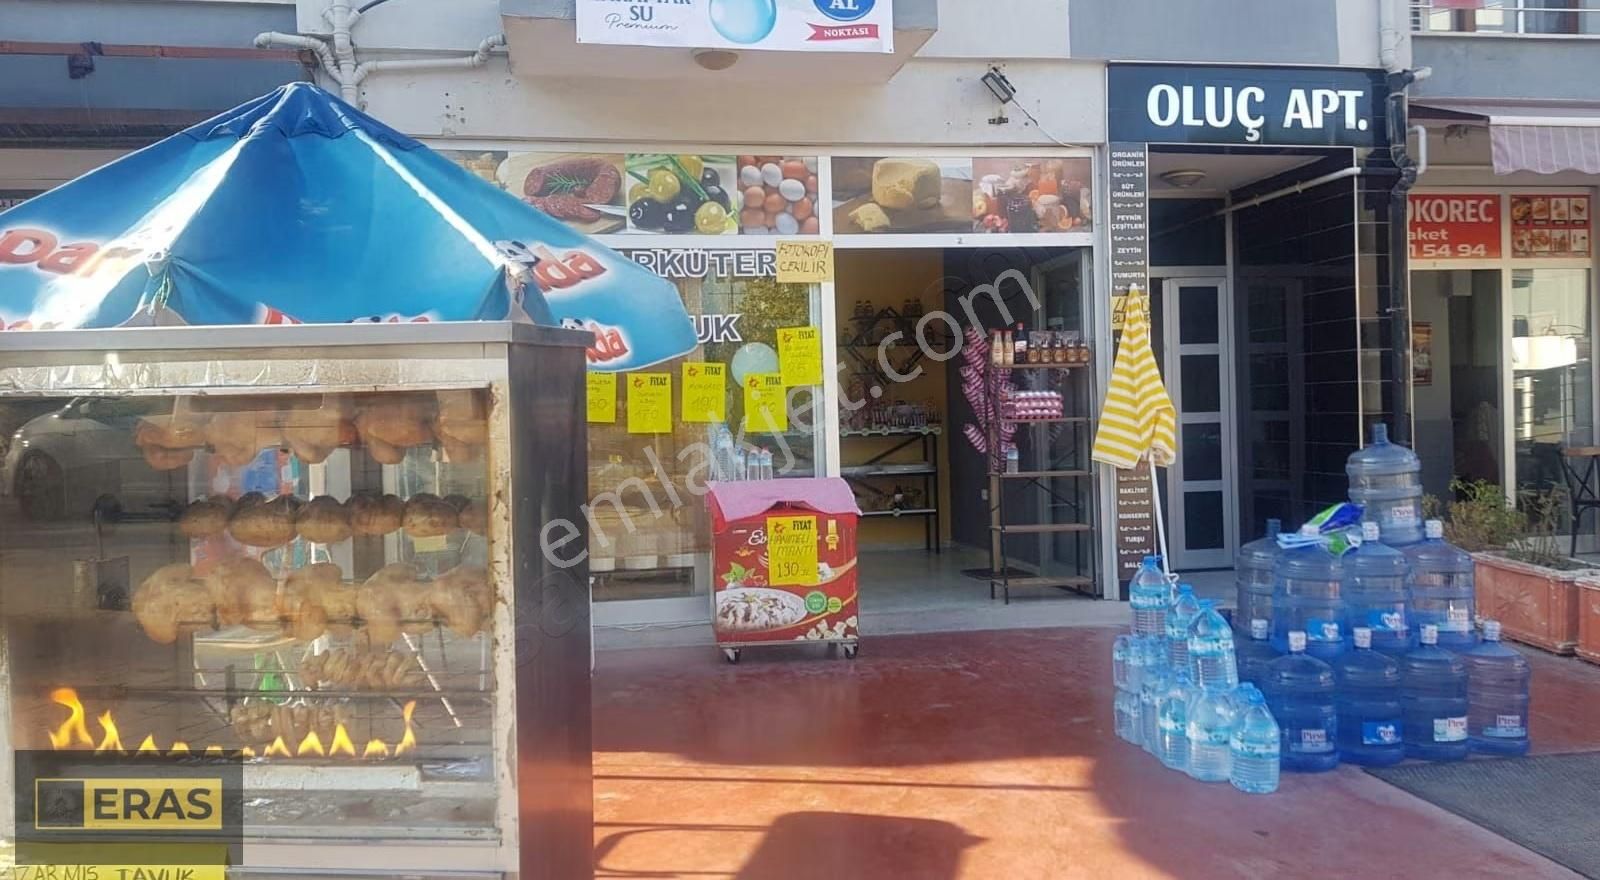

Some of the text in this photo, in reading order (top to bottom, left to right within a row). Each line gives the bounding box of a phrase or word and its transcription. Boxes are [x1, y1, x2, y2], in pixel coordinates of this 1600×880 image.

[604, 13, 680, 30] Premium
[630, 6, 653, 22] SU
[824, 27, 869, 38] NOKTASI
[1147, 84, 1368, 142] OLUÇ APT.
[1407, 227, 1449, 241] aket
[1423, 244, 1450, 257] 54
[1457, 244, 1487, 257] 94
[622, 248, 777, 277] RKÜTER
[690, 314, 742, 344] UK
[1125, 536, 1145, 544] TURŞU
